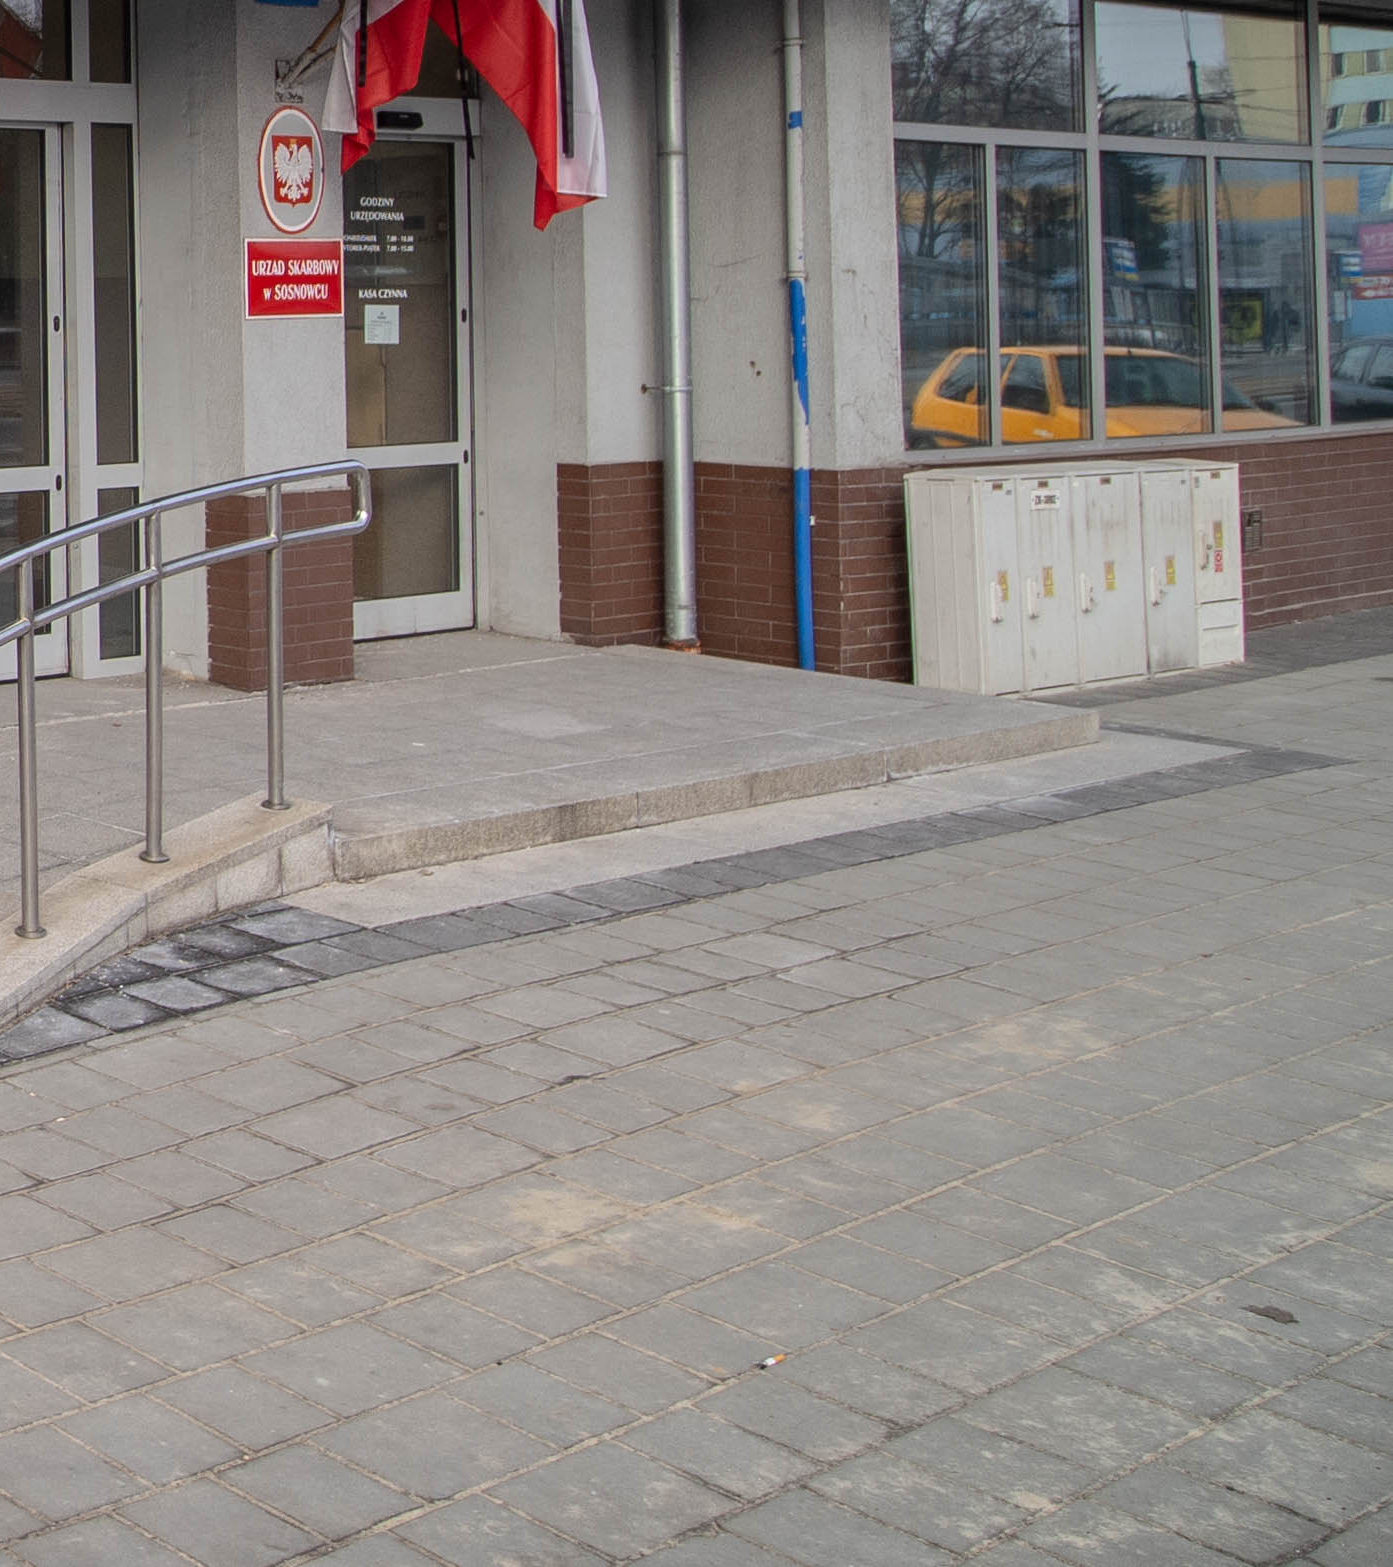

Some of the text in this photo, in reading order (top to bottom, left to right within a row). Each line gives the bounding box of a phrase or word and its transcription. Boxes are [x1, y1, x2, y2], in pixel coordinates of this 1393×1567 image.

[360, 197, 395, 207] GODZINY
[288, 259, 339, 276] SKARBOWY
[274, 284, 329, 300] SOSNOWCU
